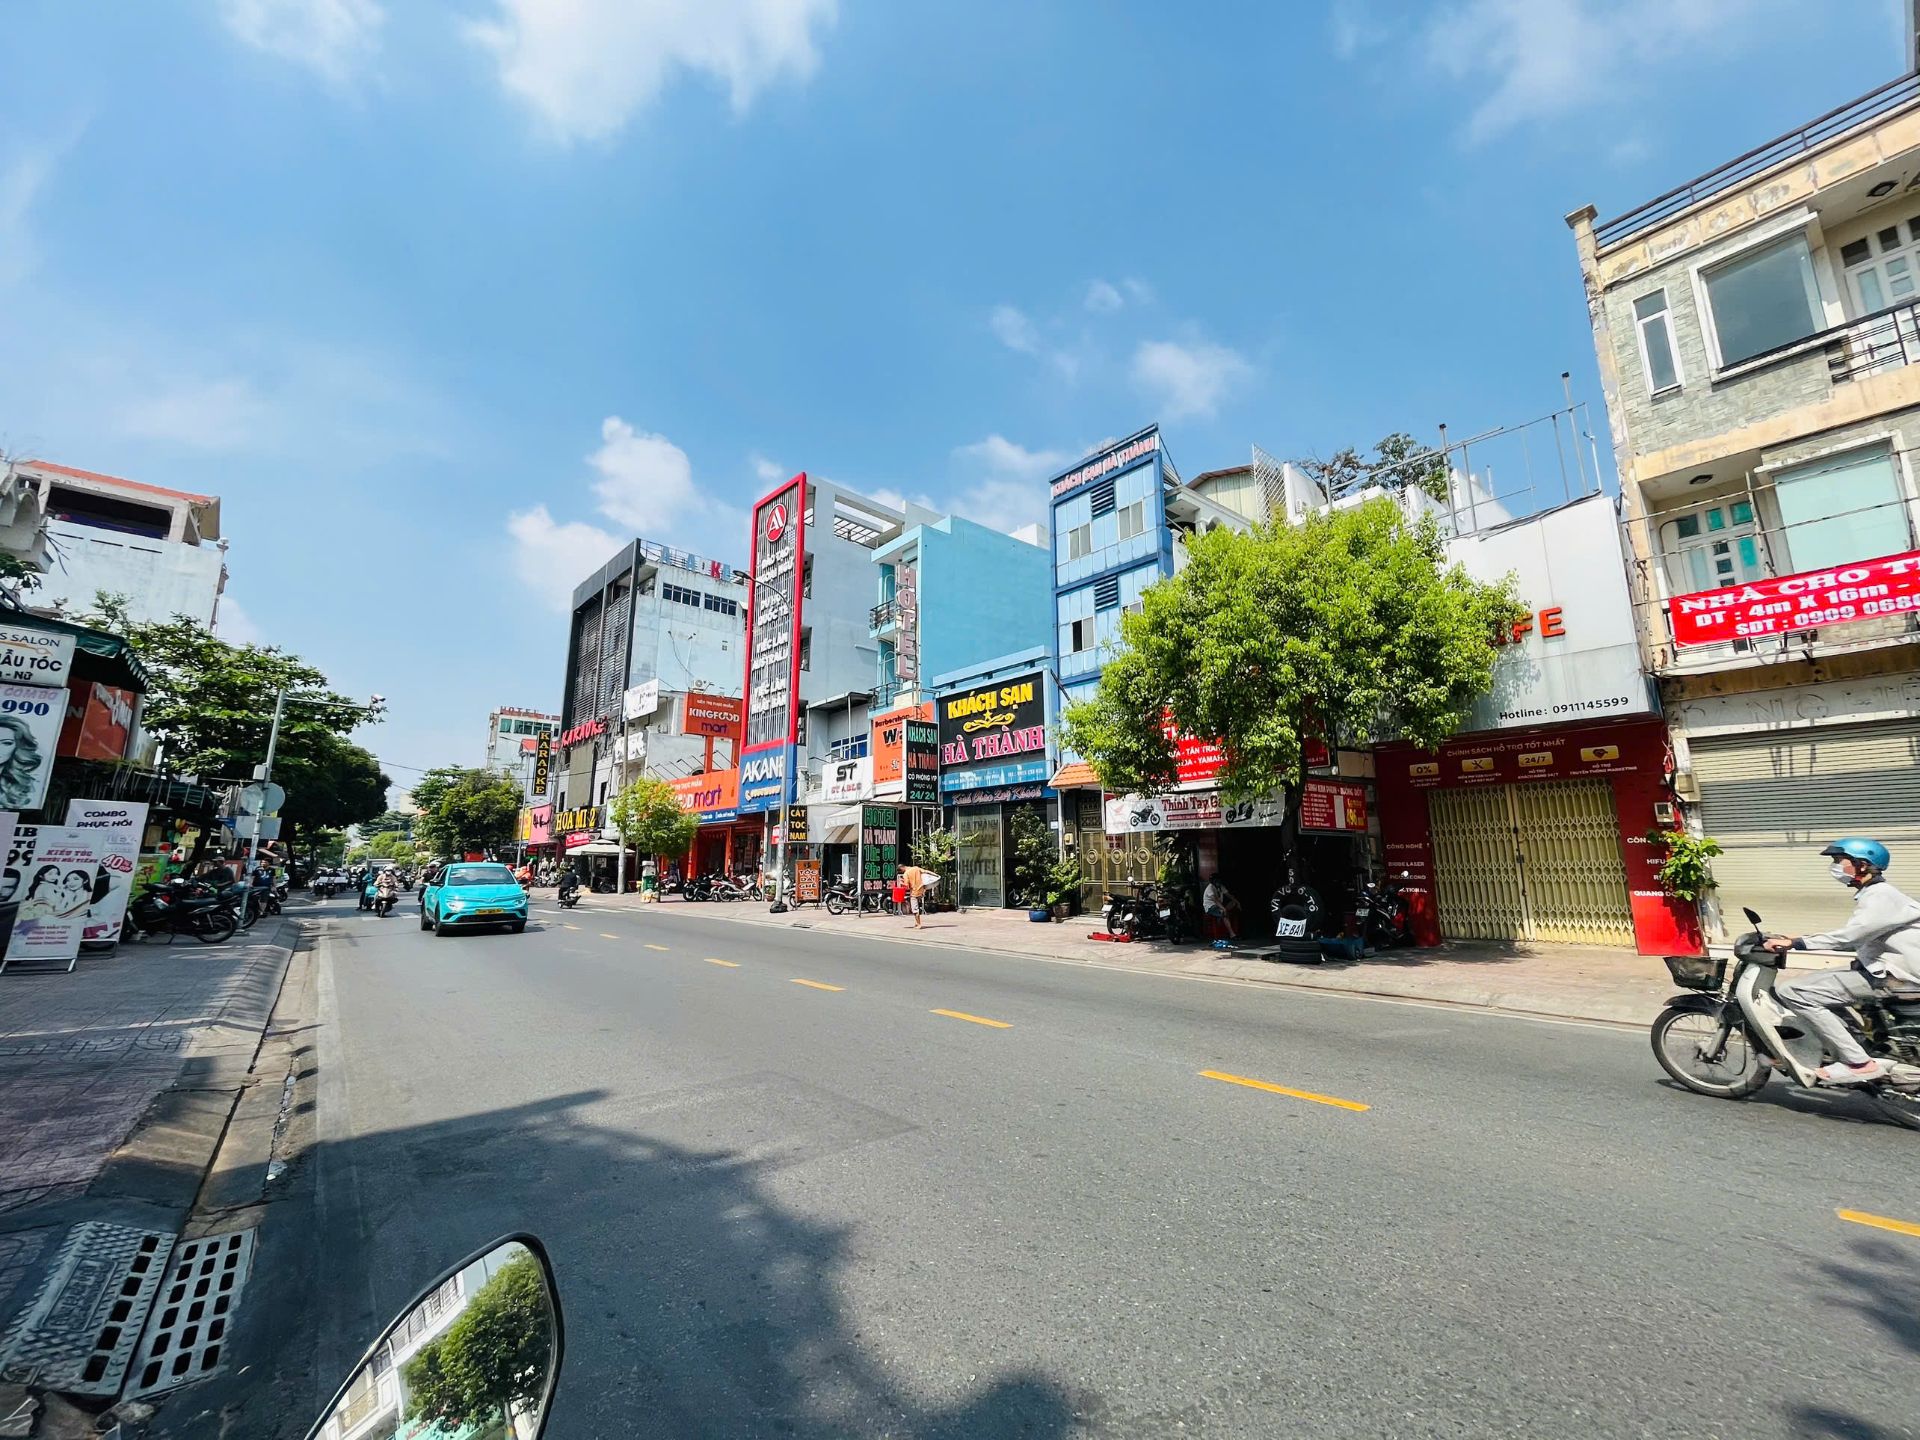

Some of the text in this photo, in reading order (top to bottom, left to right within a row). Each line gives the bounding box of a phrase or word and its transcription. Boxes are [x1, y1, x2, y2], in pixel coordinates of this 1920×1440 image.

[1679, 586, 1766, 614] NHÀ
[1778, 569, 1871, 595] CHO
[1695, 611, 1727, 627] DT
[1748, 602, 1793, 618] 4m
[1798, 595, 1818, 610] X
[1824, 585, 1889, 606] 16m
[896, 564, 917, 681] HOTEL
[1735, 619, 1776, 636] SDT
[1794, 605, 1857, 626] 0909
[11, 634, 61, 647] SALON
[0, 649, 63, 672] ẪU TÓC
[2, 699, 49, 716] 990
[948, 683, 1033, 719] KHÁCH SẠN
[1499, 696, 1628, 720] Hotline: 0911145599
[689, 707, 740, 723] KINGFOOD
[701, 721, 727, 734] mart
[908, 722, 926, 744] KHÁCH
[941, 725, 1044, 765] HÀ THÀNH
[536, 731, 549, 794] KARAOKE
[1525, 755, 1546, 764] 24/7
[916, 772, 930, 782] PHÒNG
[694, 784, 721, 808] mart
[909, 791, 935, 800] 24/24
[84, 810, 127, 818] COMBO
[588, 807, 597, 827] 2
[864, 807, 896, 827] HOTEL
[789, 832, 806, 840] NAM
[1279, 922, 1290, 934] XE
